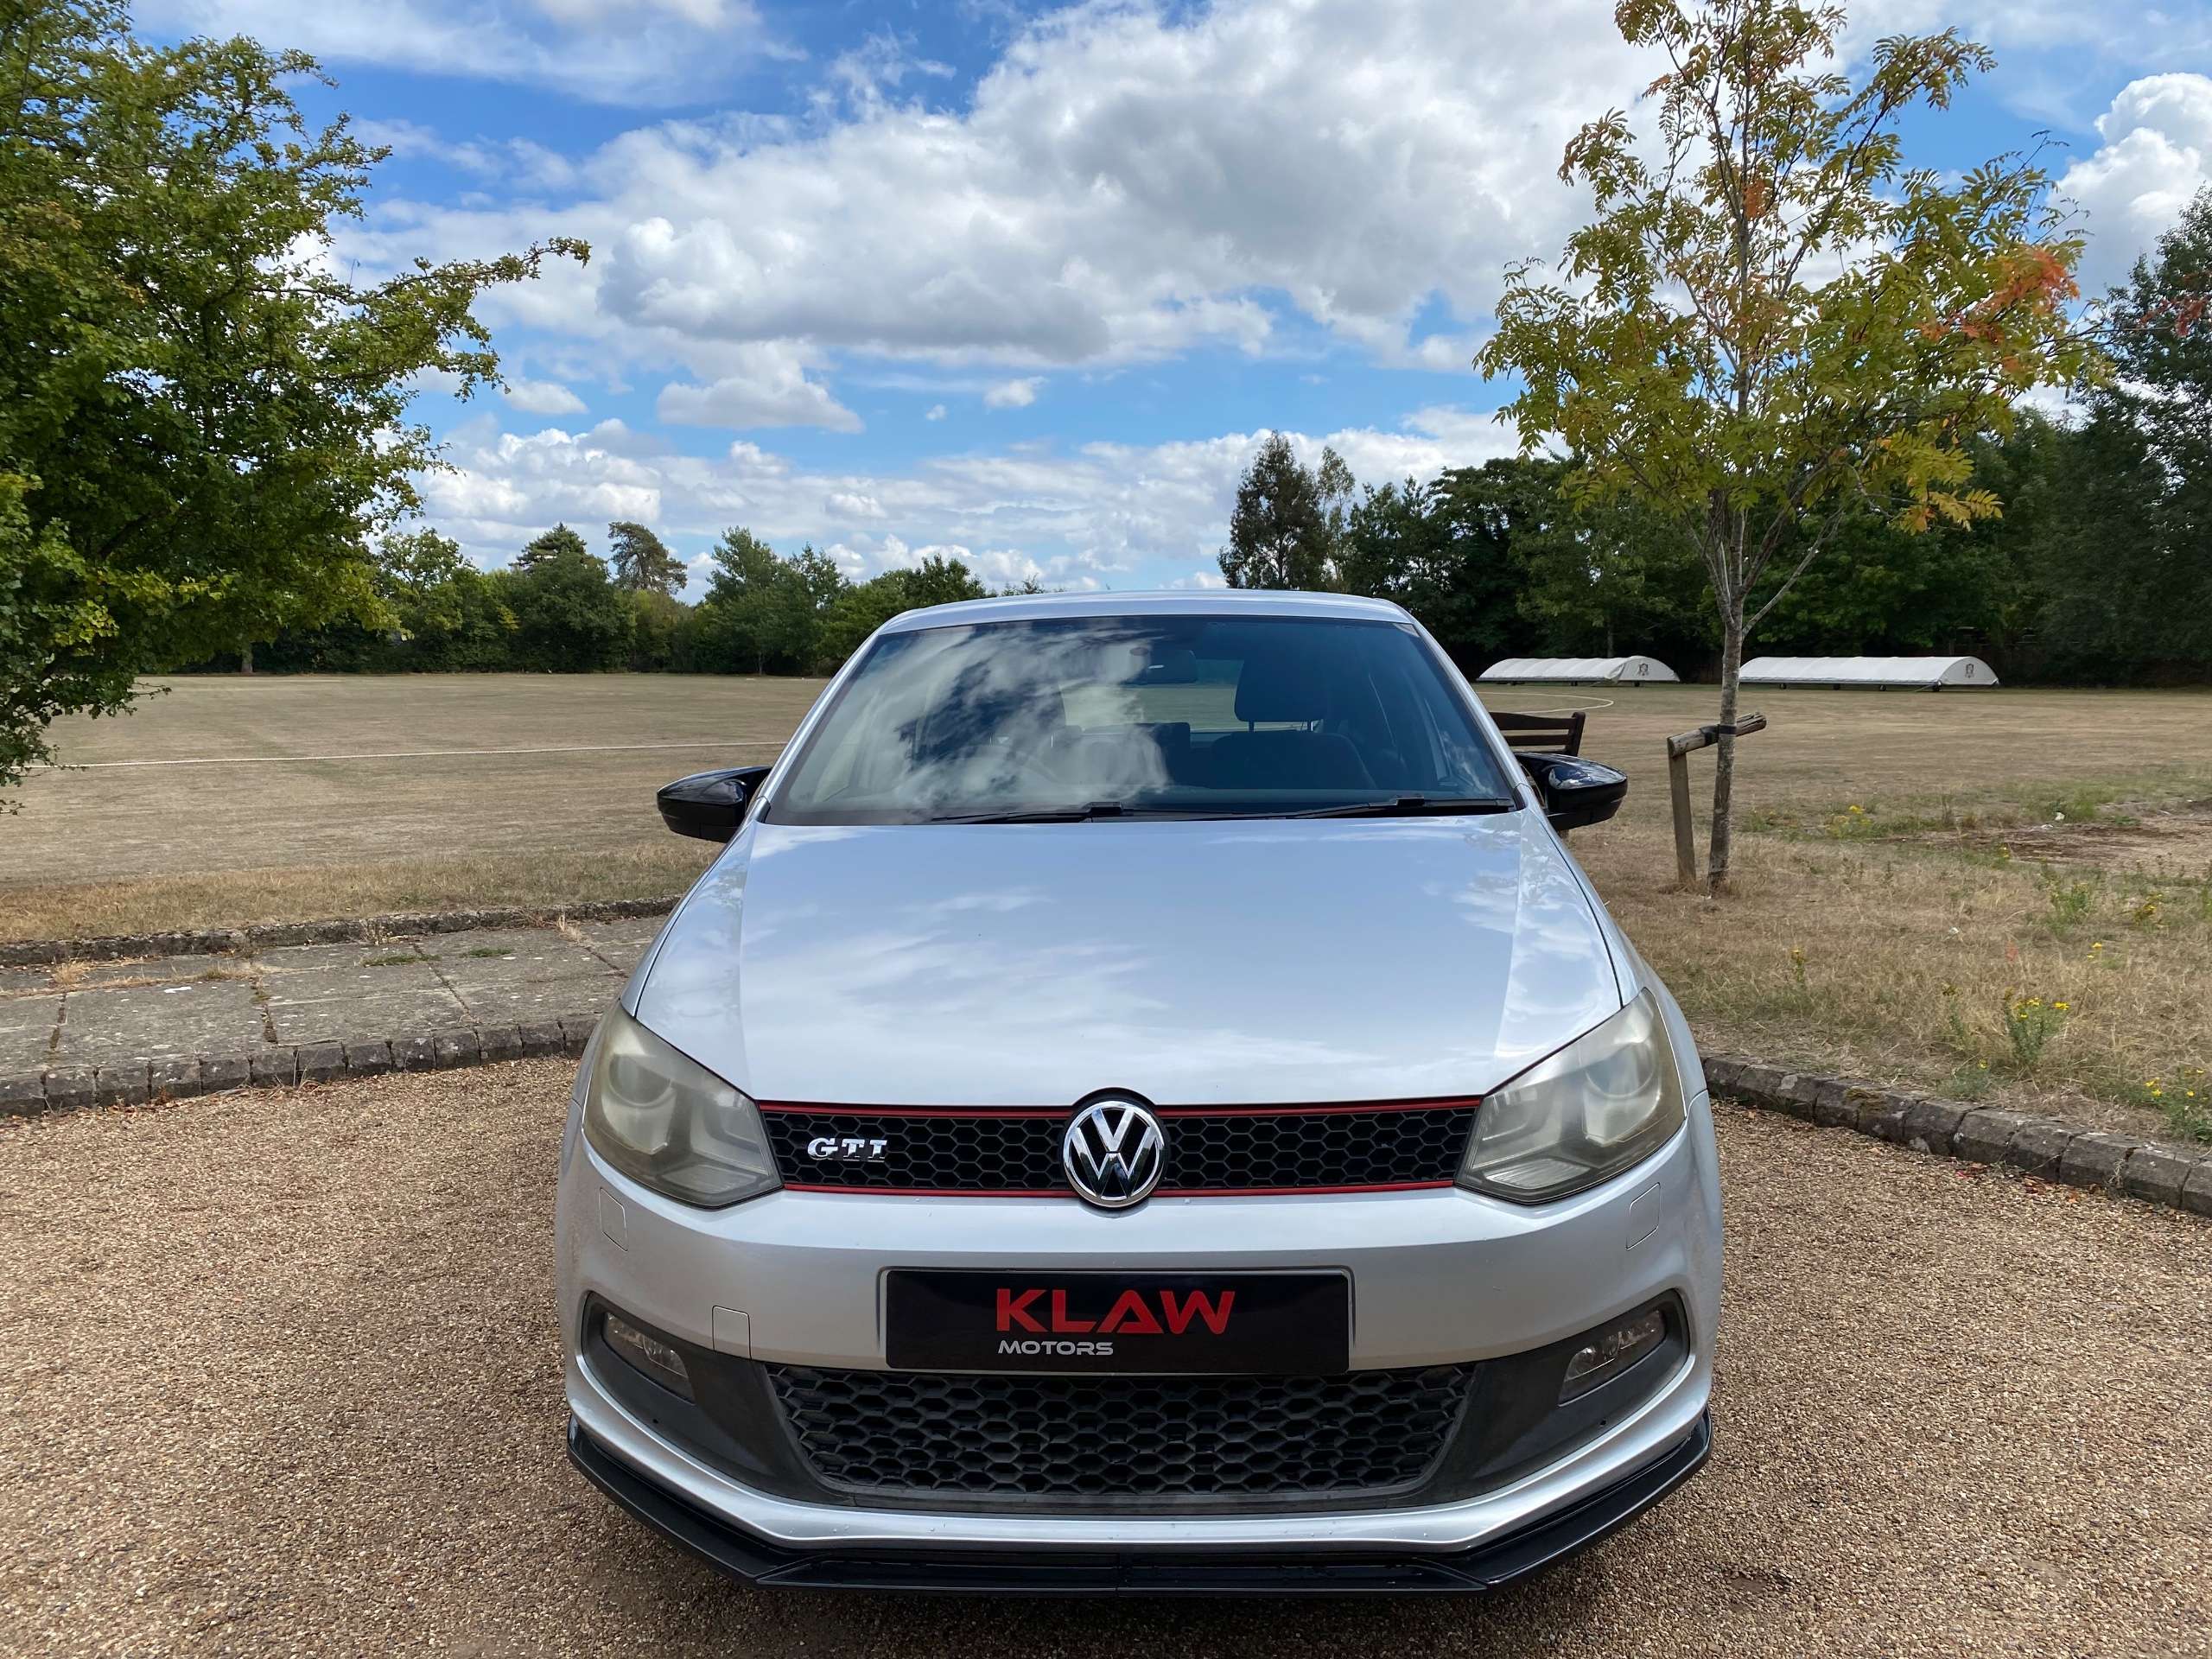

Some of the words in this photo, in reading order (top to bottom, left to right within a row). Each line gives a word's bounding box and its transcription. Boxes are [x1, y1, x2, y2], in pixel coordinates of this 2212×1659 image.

[807, 1137, 887, 1162] GTI
[996, 1288, 1236, 1335] KLAW
[997, 1339, 1114, 1356] MOTORS
